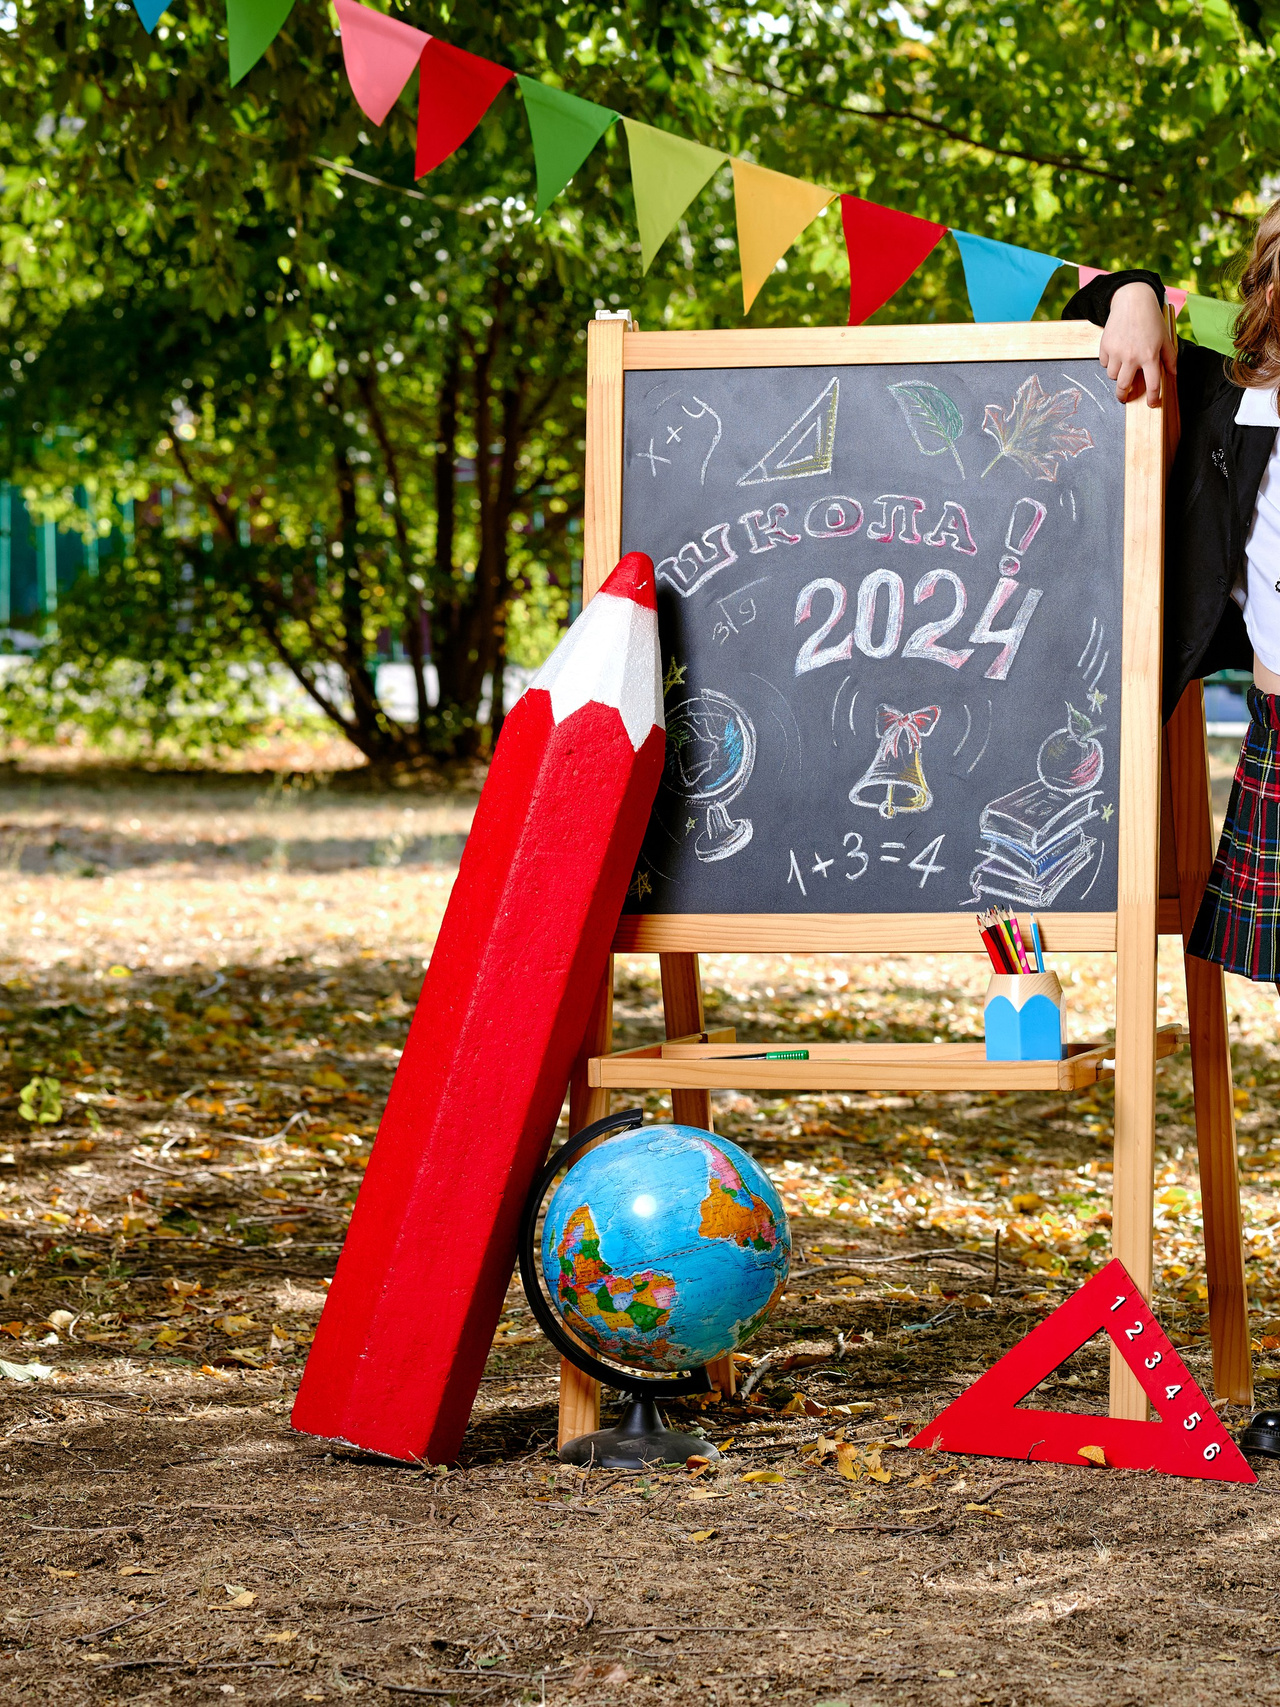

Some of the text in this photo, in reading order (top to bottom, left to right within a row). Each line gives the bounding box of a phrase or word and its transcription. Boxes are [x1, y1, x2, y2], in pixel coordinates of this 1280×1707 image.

[655, 494, 1048, 597] ШКОЛА!
[794, 569, 1044, 680] 2024
[1110, 1295, 1221, 1461] 1 2 3 4 5 6
